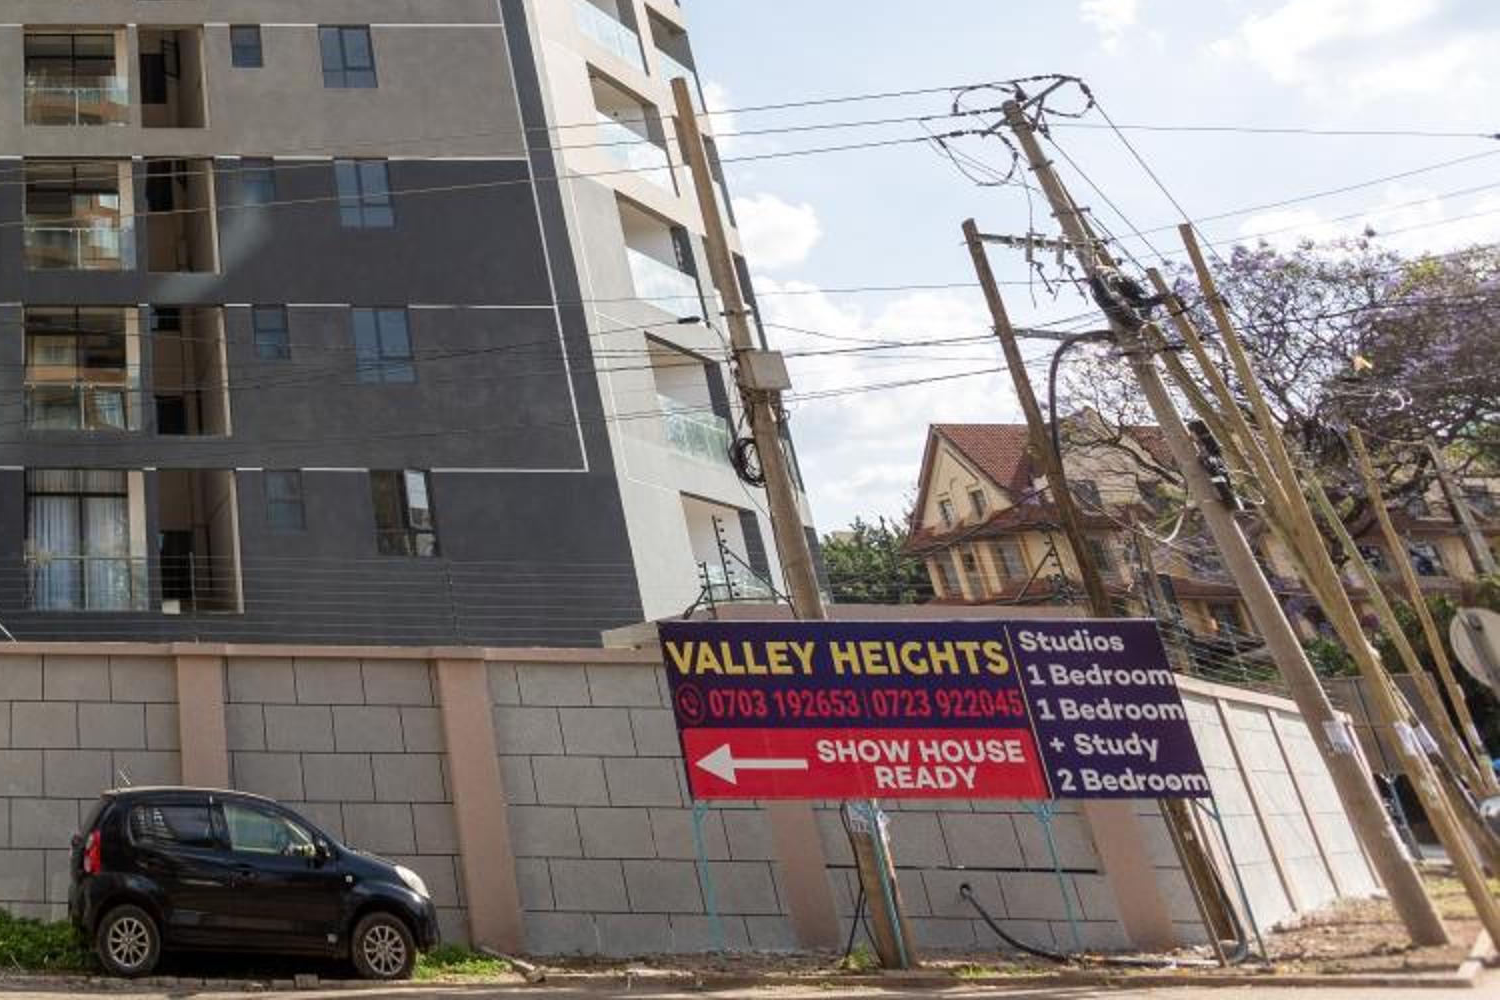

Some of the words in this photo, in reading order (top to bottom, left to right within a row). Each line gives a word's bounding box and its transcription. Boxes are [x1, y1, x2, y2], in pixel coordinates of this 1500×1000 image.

[1018, 629, 1125, 651] Studios
[665, 641, 815, 674] VALLEY
[829, 641, 1009, 675] HEIGHTS
[1027, 664, 1046, 686] 1
[1048, 664, 1174, 686] Bedroom
[707, 688, 768, 719] 0703
[773, 688, 861, 719] 192653
[871, 688, 932, 718] 0723
[934, 688, 1025, 718] 922045
[1037, 699, 1056, 721] 1
[1059, 698, 1188, 721] Bedroom
[817, 739, 910, 763] SHOW
[918, 739, 1026, 763] HOUSE
[1073, 732, 1159, 762] Study
[875, 766, 977, 789] READY
[1057, 768, 1077, 792] 2
[1079, 768, 1209, 792] Bedroom
